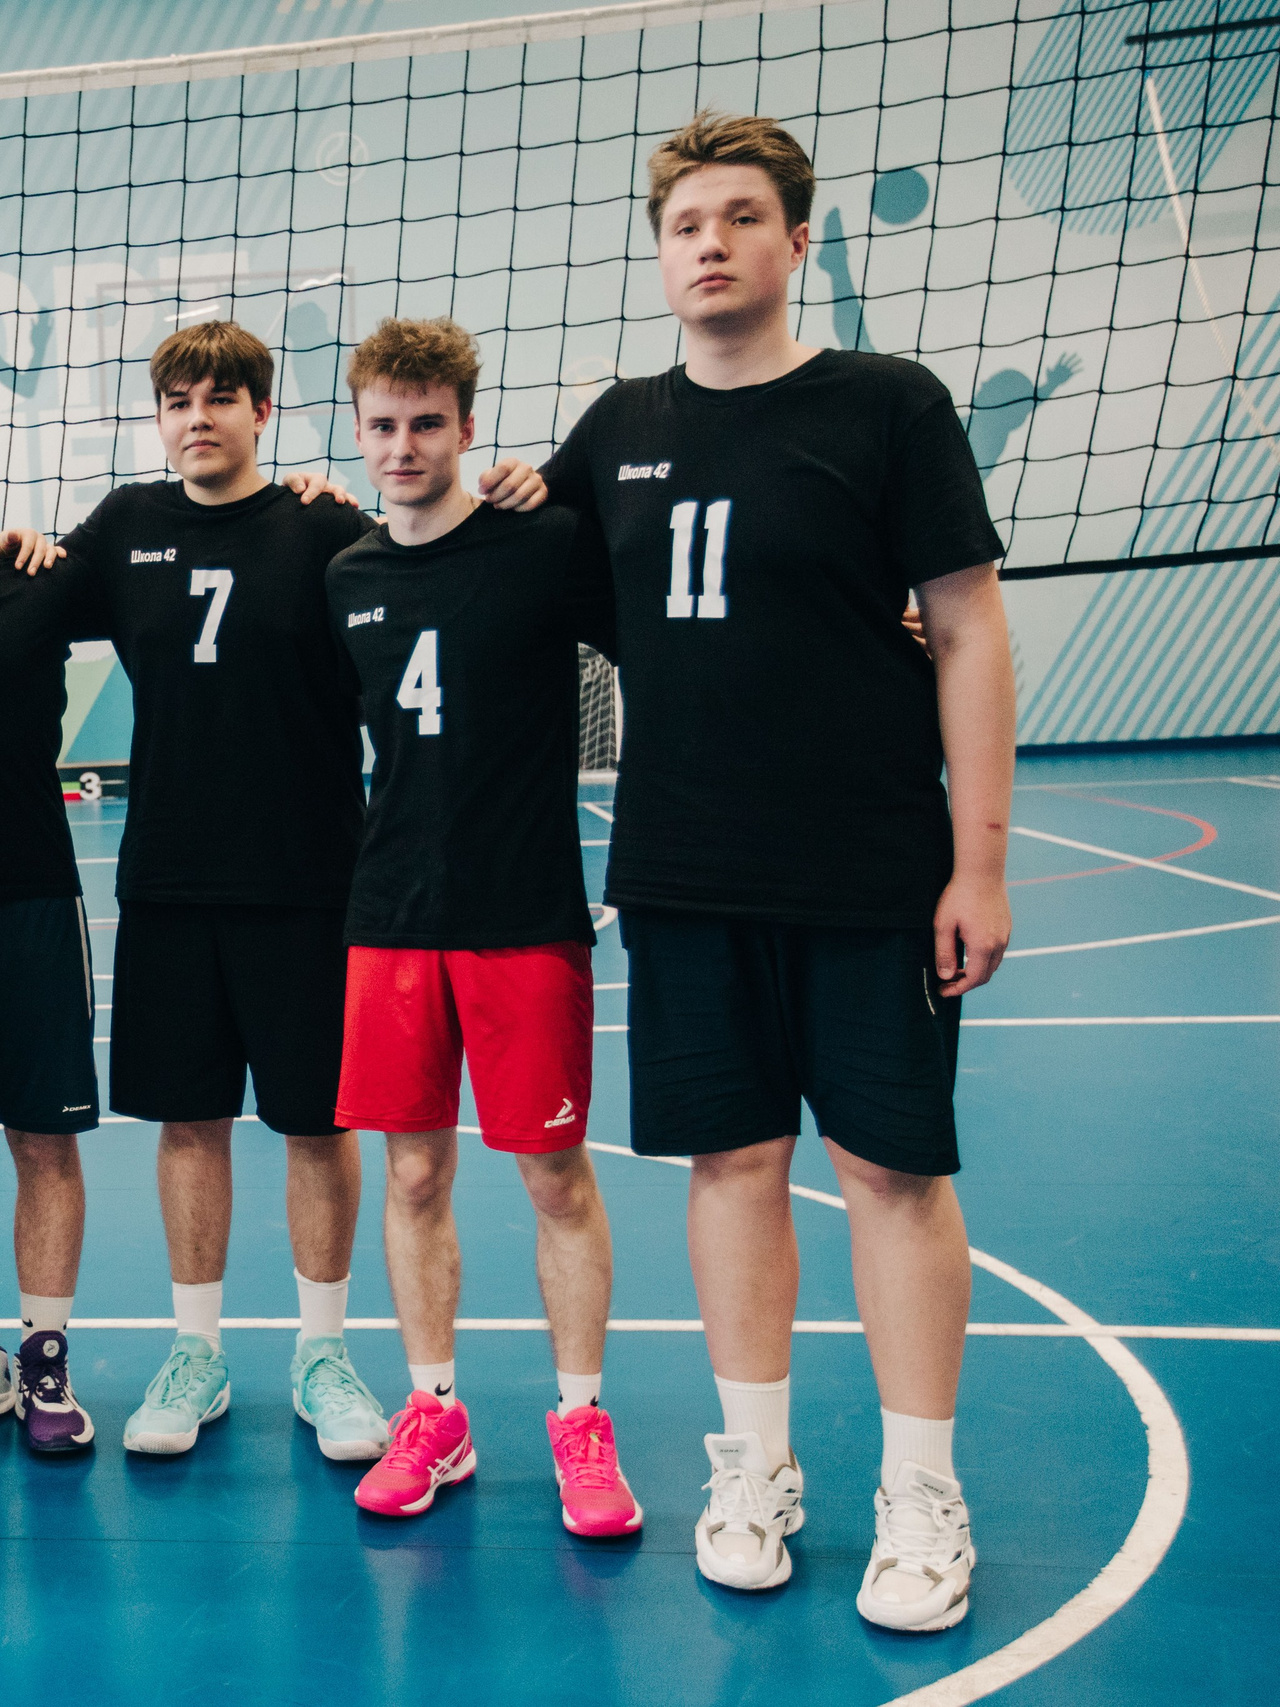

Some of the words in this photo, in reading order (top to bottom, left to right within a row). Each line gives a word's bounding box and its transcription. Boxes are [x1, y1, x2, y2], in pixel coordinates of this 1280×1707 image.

[618, 464, 652, 480] Школа
[653, 463, 670, 479] 42
[130, 550, 162, 564] Школа
[163, 548, 177, 562] 42
[666, 500, 731, 618] 11
[189, 569, 234, 663] 7
[347, 611, 371, 628] Школа
[372, 607, 385, 622] 42
[396, 629, 442, 736] 4
[79, 771, 102, 801] 3
